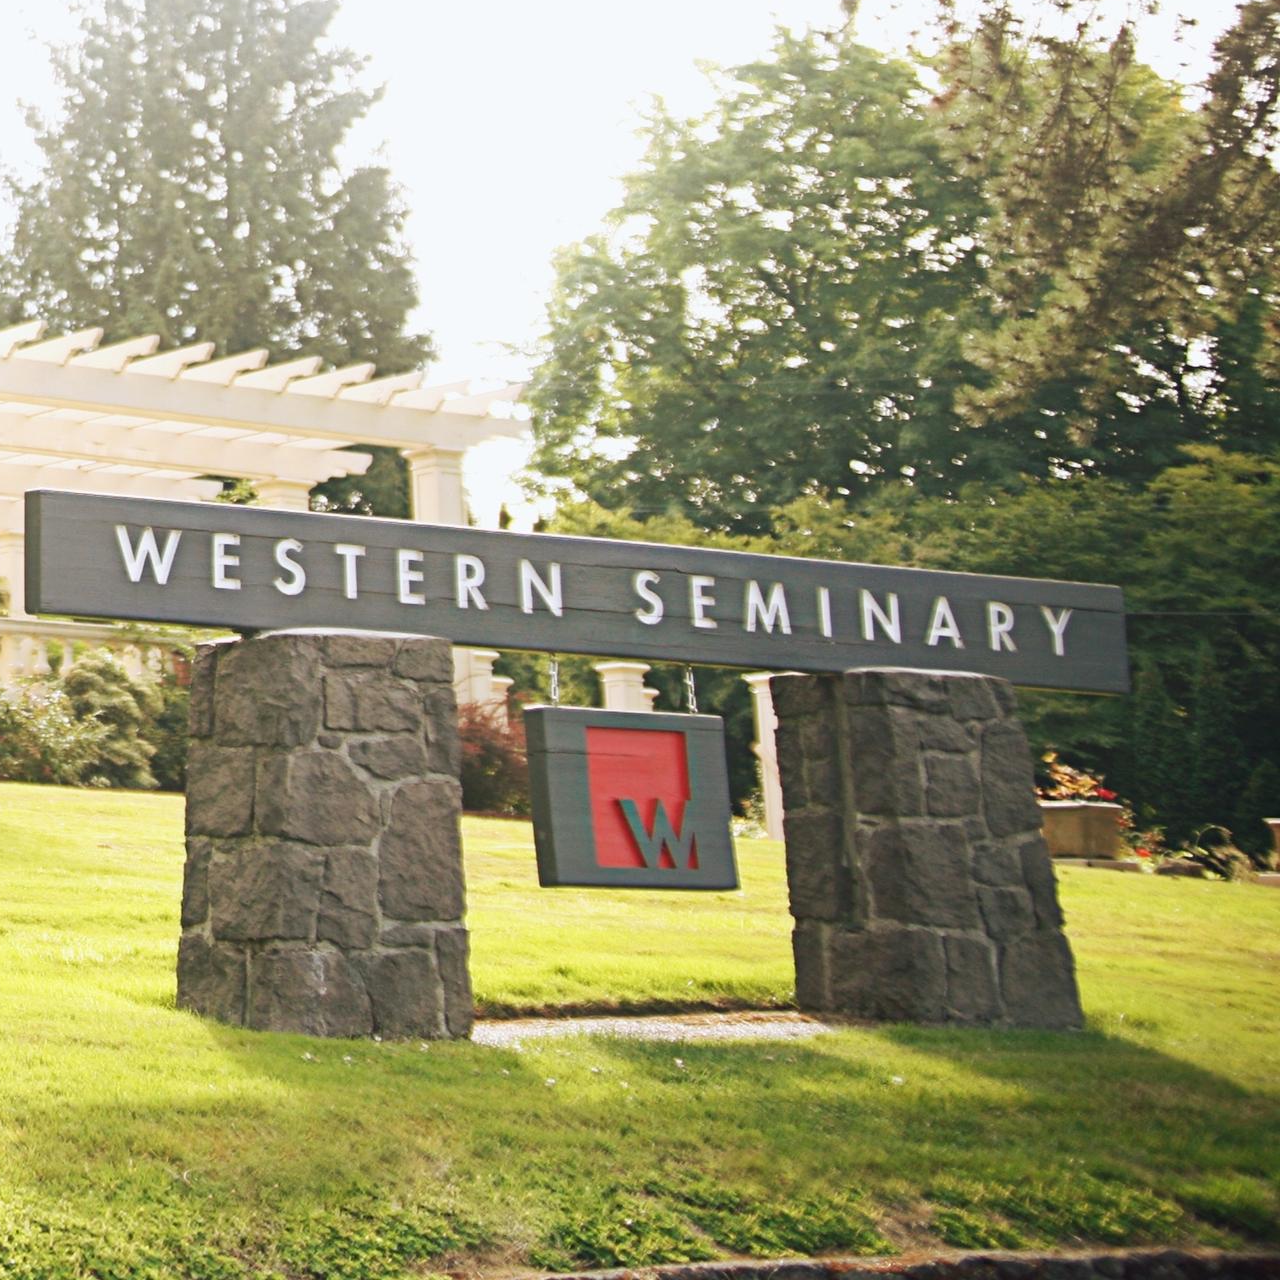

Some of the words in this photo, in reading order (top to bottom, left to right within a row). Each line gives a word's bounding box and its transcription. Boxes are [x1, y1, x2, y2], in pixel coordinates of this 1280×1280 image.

[114, 523, 564, 617] WESTERN
[633, 569, 1074, 658] SEMINARY
[618, 797, 700, 869] W
